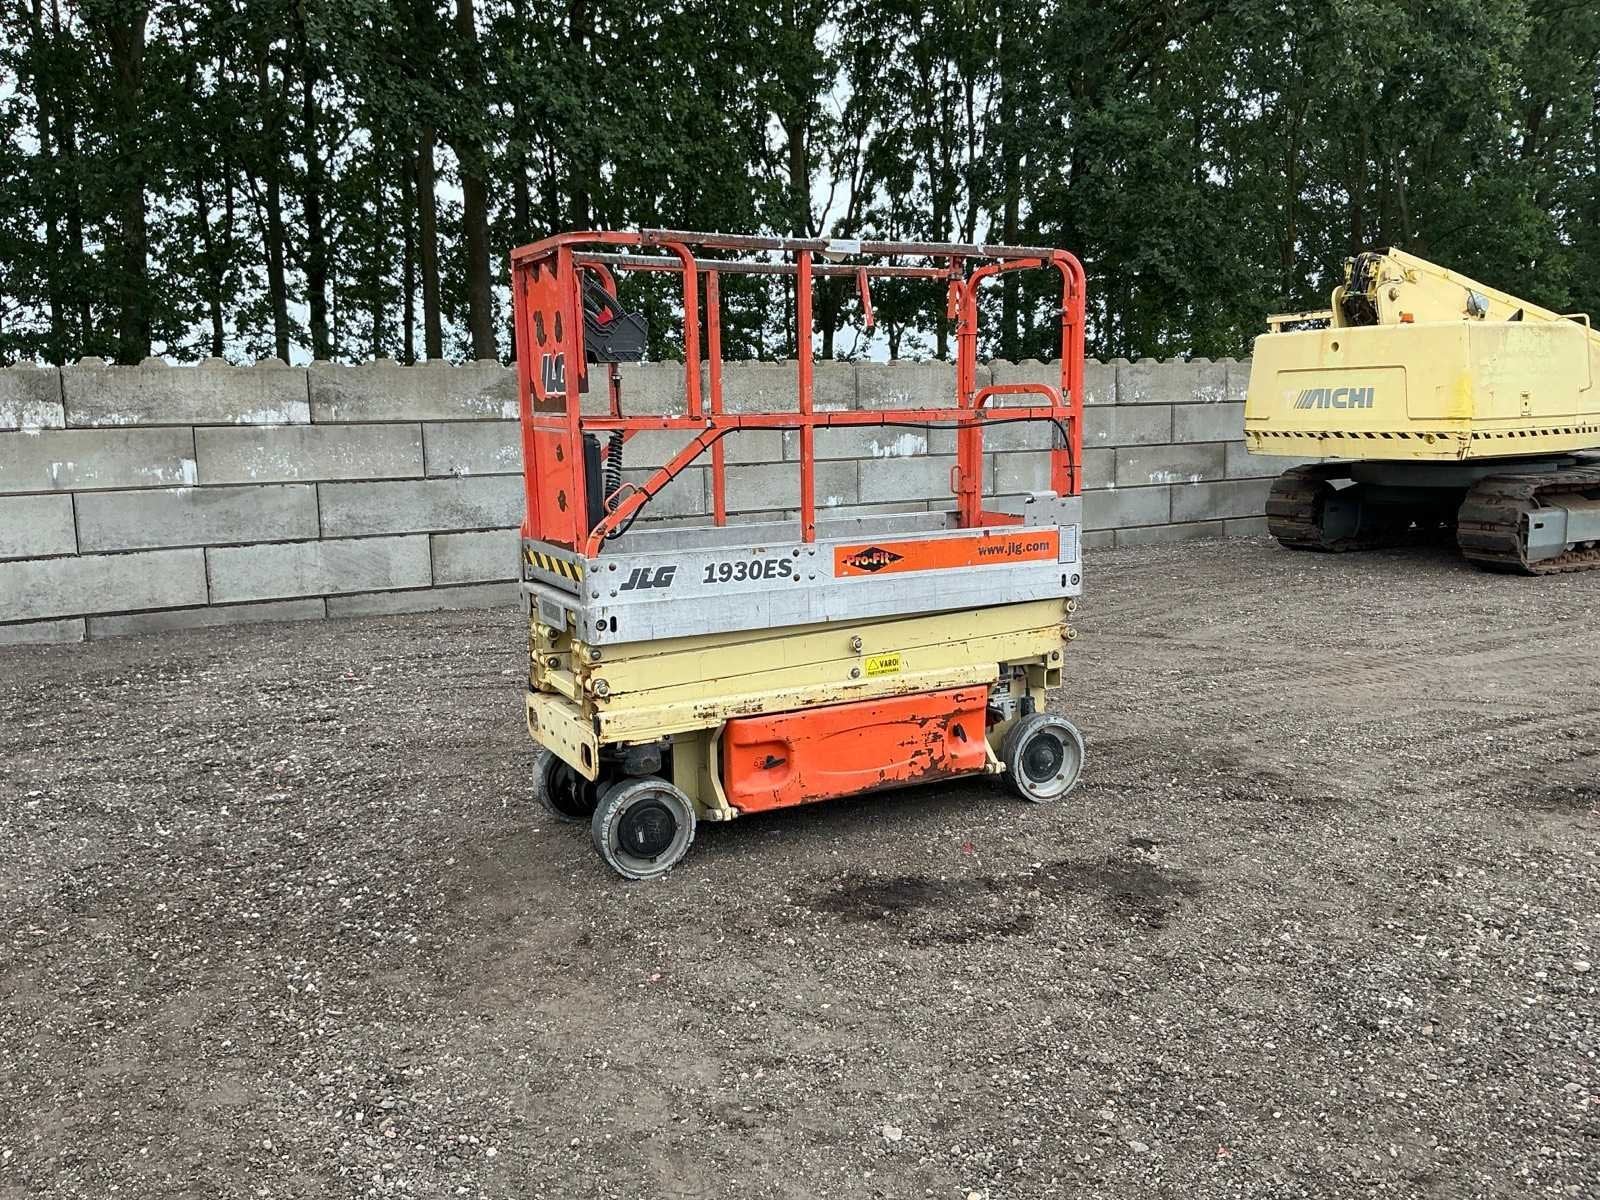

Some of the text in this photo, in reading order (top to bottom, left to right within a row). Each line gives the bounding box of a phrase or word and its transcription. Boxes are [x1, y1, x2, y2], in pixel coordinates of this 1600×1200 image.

[1299, 387, 1375, 409] AICHI
[978, 542, 1050, 556] www.jlg.com
[619, 558, 793, 591] JLG 1930ES
